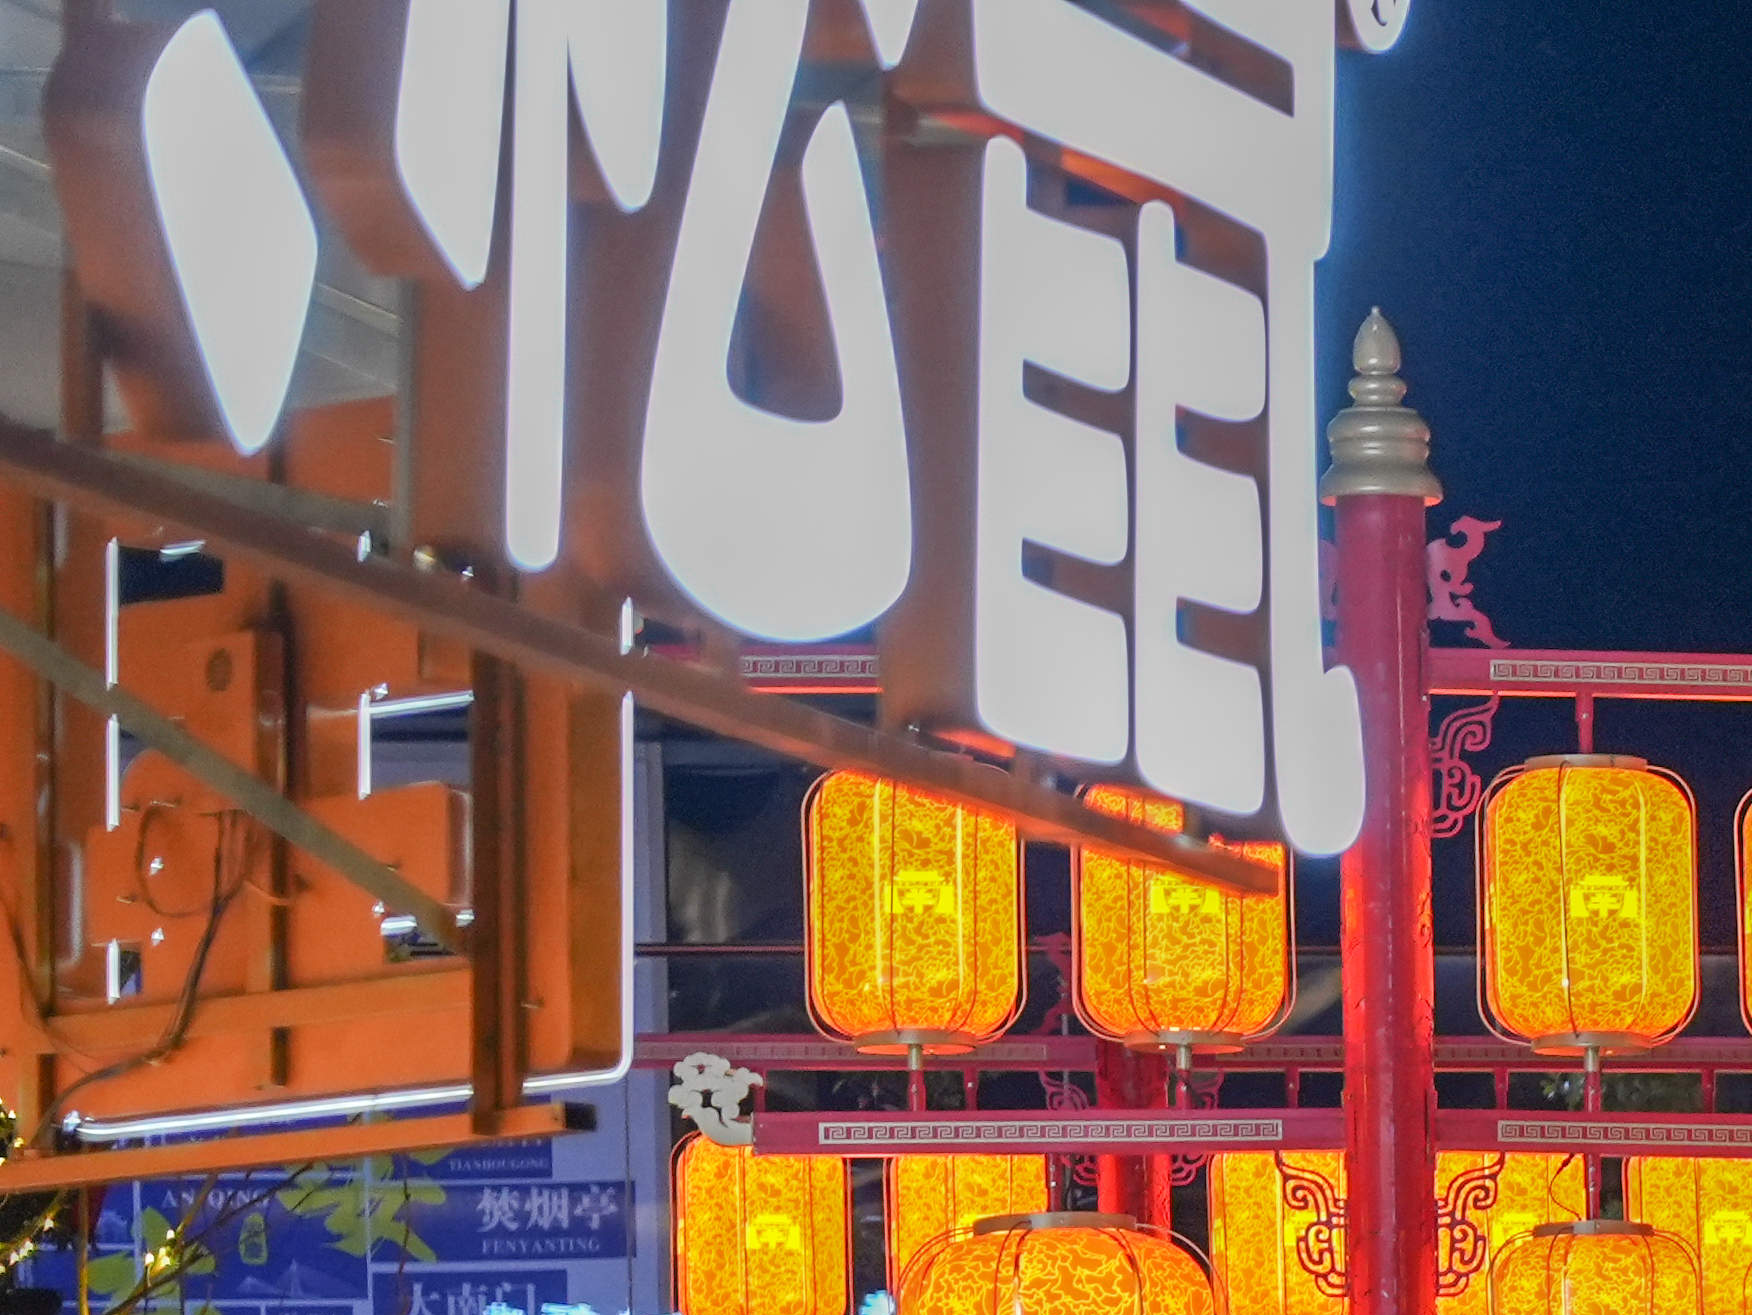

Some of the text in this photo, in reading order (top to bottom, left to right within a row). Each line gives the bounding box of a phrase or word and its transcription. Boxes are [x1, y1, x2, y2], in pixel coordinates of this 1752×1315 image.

[476, 1185, 619, 1232] 焚烟亭
[482, 1238, 600, 1254] FENYANTING
